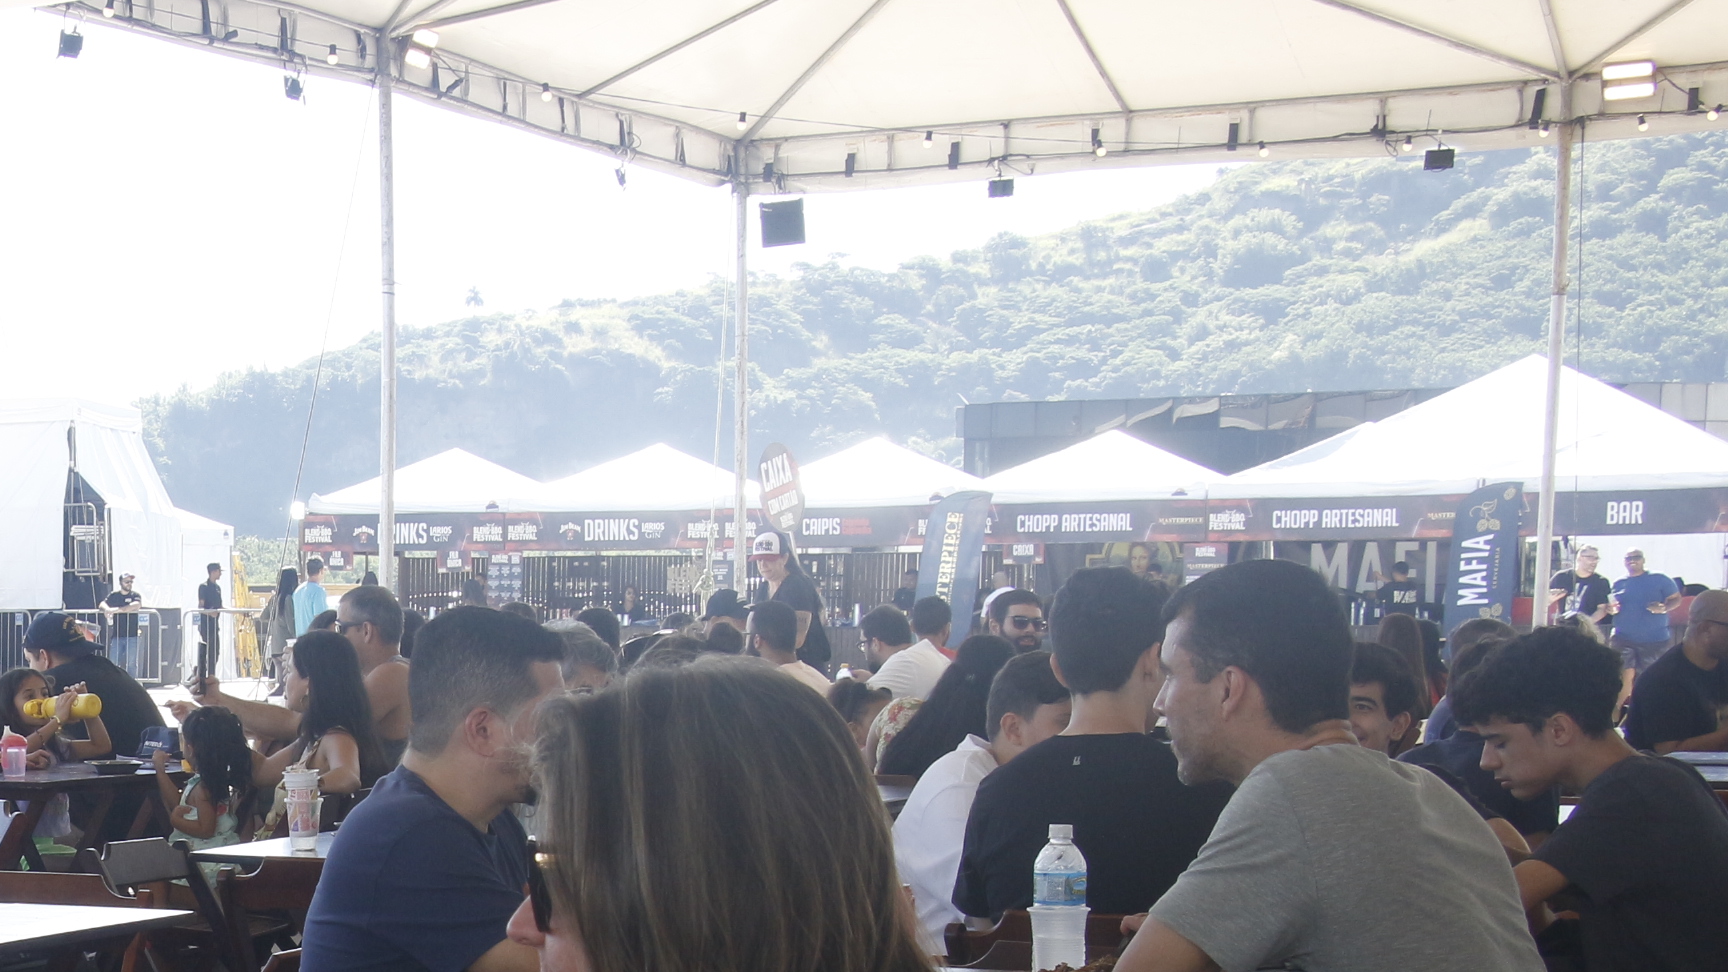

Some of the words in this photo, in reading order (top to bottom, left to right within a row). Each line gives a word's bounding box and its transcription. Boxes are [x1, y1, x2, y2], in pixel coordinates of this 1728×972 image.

[760, 452, 792, 492] CAIXA
[1158, 516, 1204, 526] MASTERPIECE
[1272, 510, 1318, 529] CHOPP
[1322, 508, 1400, 528] ARTESANAL
[1606, 500, 1644, 524] BAR
[584, 518, 638, 541] DRINKS
[641, 522, 664, 532] LARIOS
[802, 518, 840, 536] CAIPIS
[1016, 514, 1058, 534] CHOPP
[1061, 512, 1133, 533] ARTESANAL
[1208, 520, 1246, 531] FESTIVAL
[304, 535, 332, 544] FESTIVAL
[472, 533, 503, 542] FESTIVAL
[508, 532, 538, 541] FESTIVAL
[644, 530, 662, 539] GIN
[1310, 541, 1438, 604] MAFI
[1457, 533, 1494, 606] MAFIA
